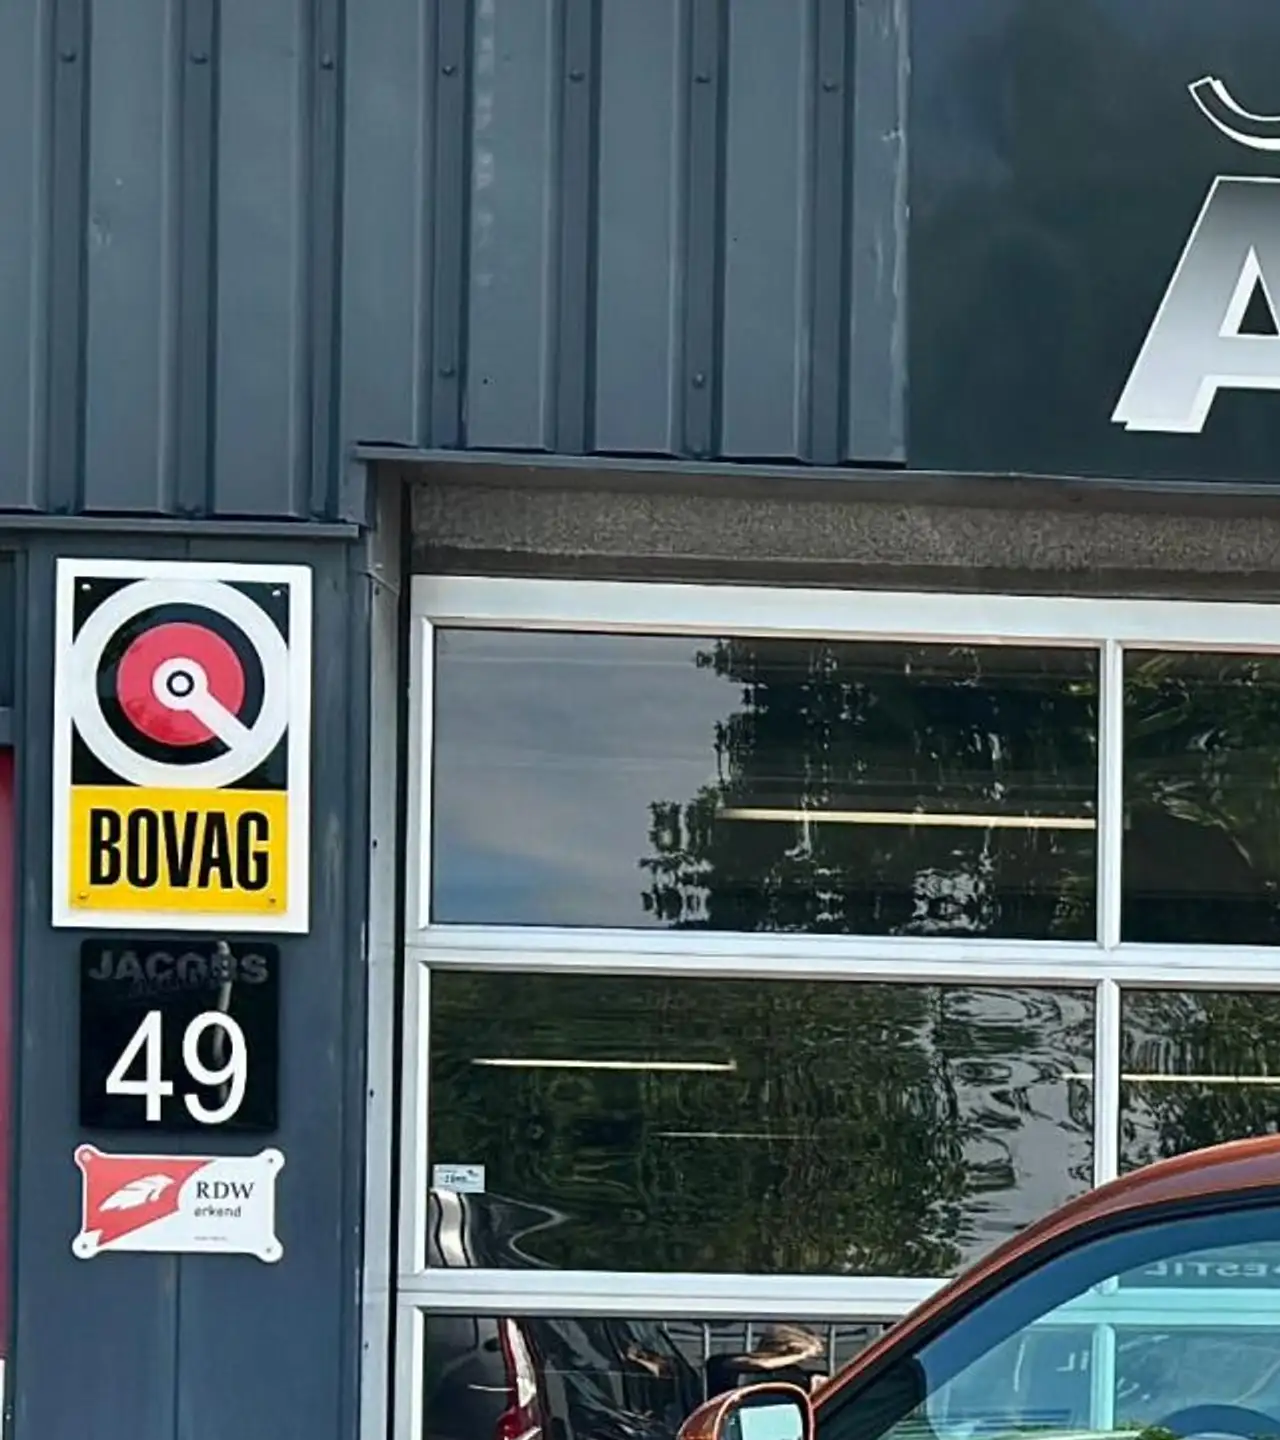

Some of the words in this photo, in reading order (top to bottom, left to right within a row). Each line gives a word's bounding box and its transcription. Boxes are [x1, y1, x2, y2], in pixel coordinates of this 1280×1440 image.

[90, 808, 269, 890] BOVAG
[105, 1010, 248, 1124] 49
[193, 1205, 242, 1218] erkend
[195, 1180, 256, 1200] RDW
